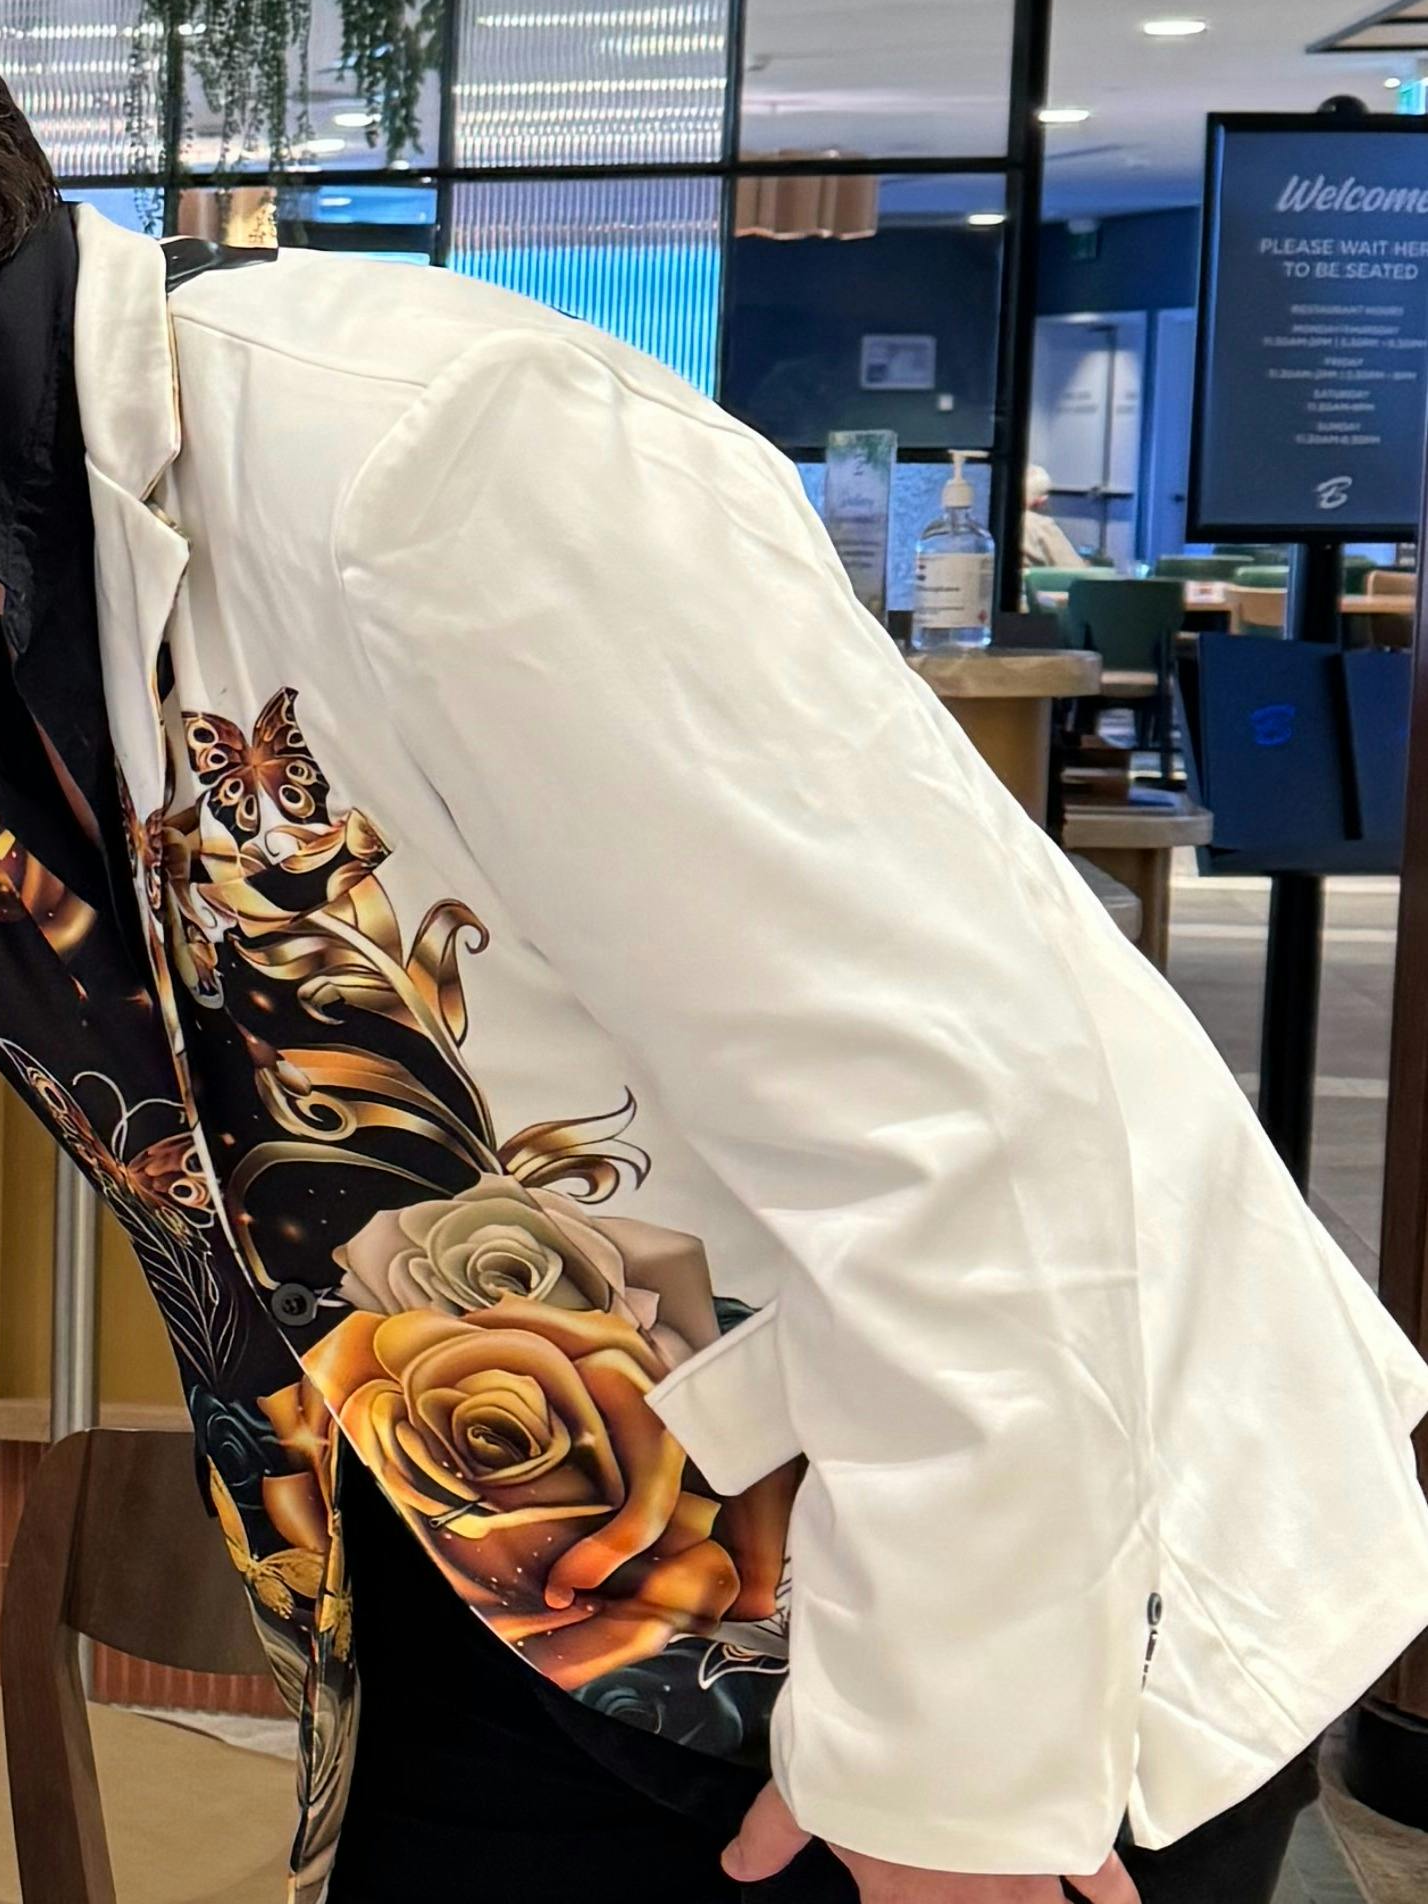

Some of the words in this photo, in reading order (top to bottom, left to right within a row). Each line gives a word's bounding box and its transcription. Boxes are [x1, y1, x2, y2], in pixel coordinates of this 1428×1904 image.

[1276, 174, 1428, 214] Welcome
[1259, 237, 1334, 255] PLEASE
[1340, 239, 1388, 256] WAIT
[1283, 261, 1310, 278] TO
[1315, 262, 1339, 278] BE
[1345, 262, 1418, 280] SEATED
